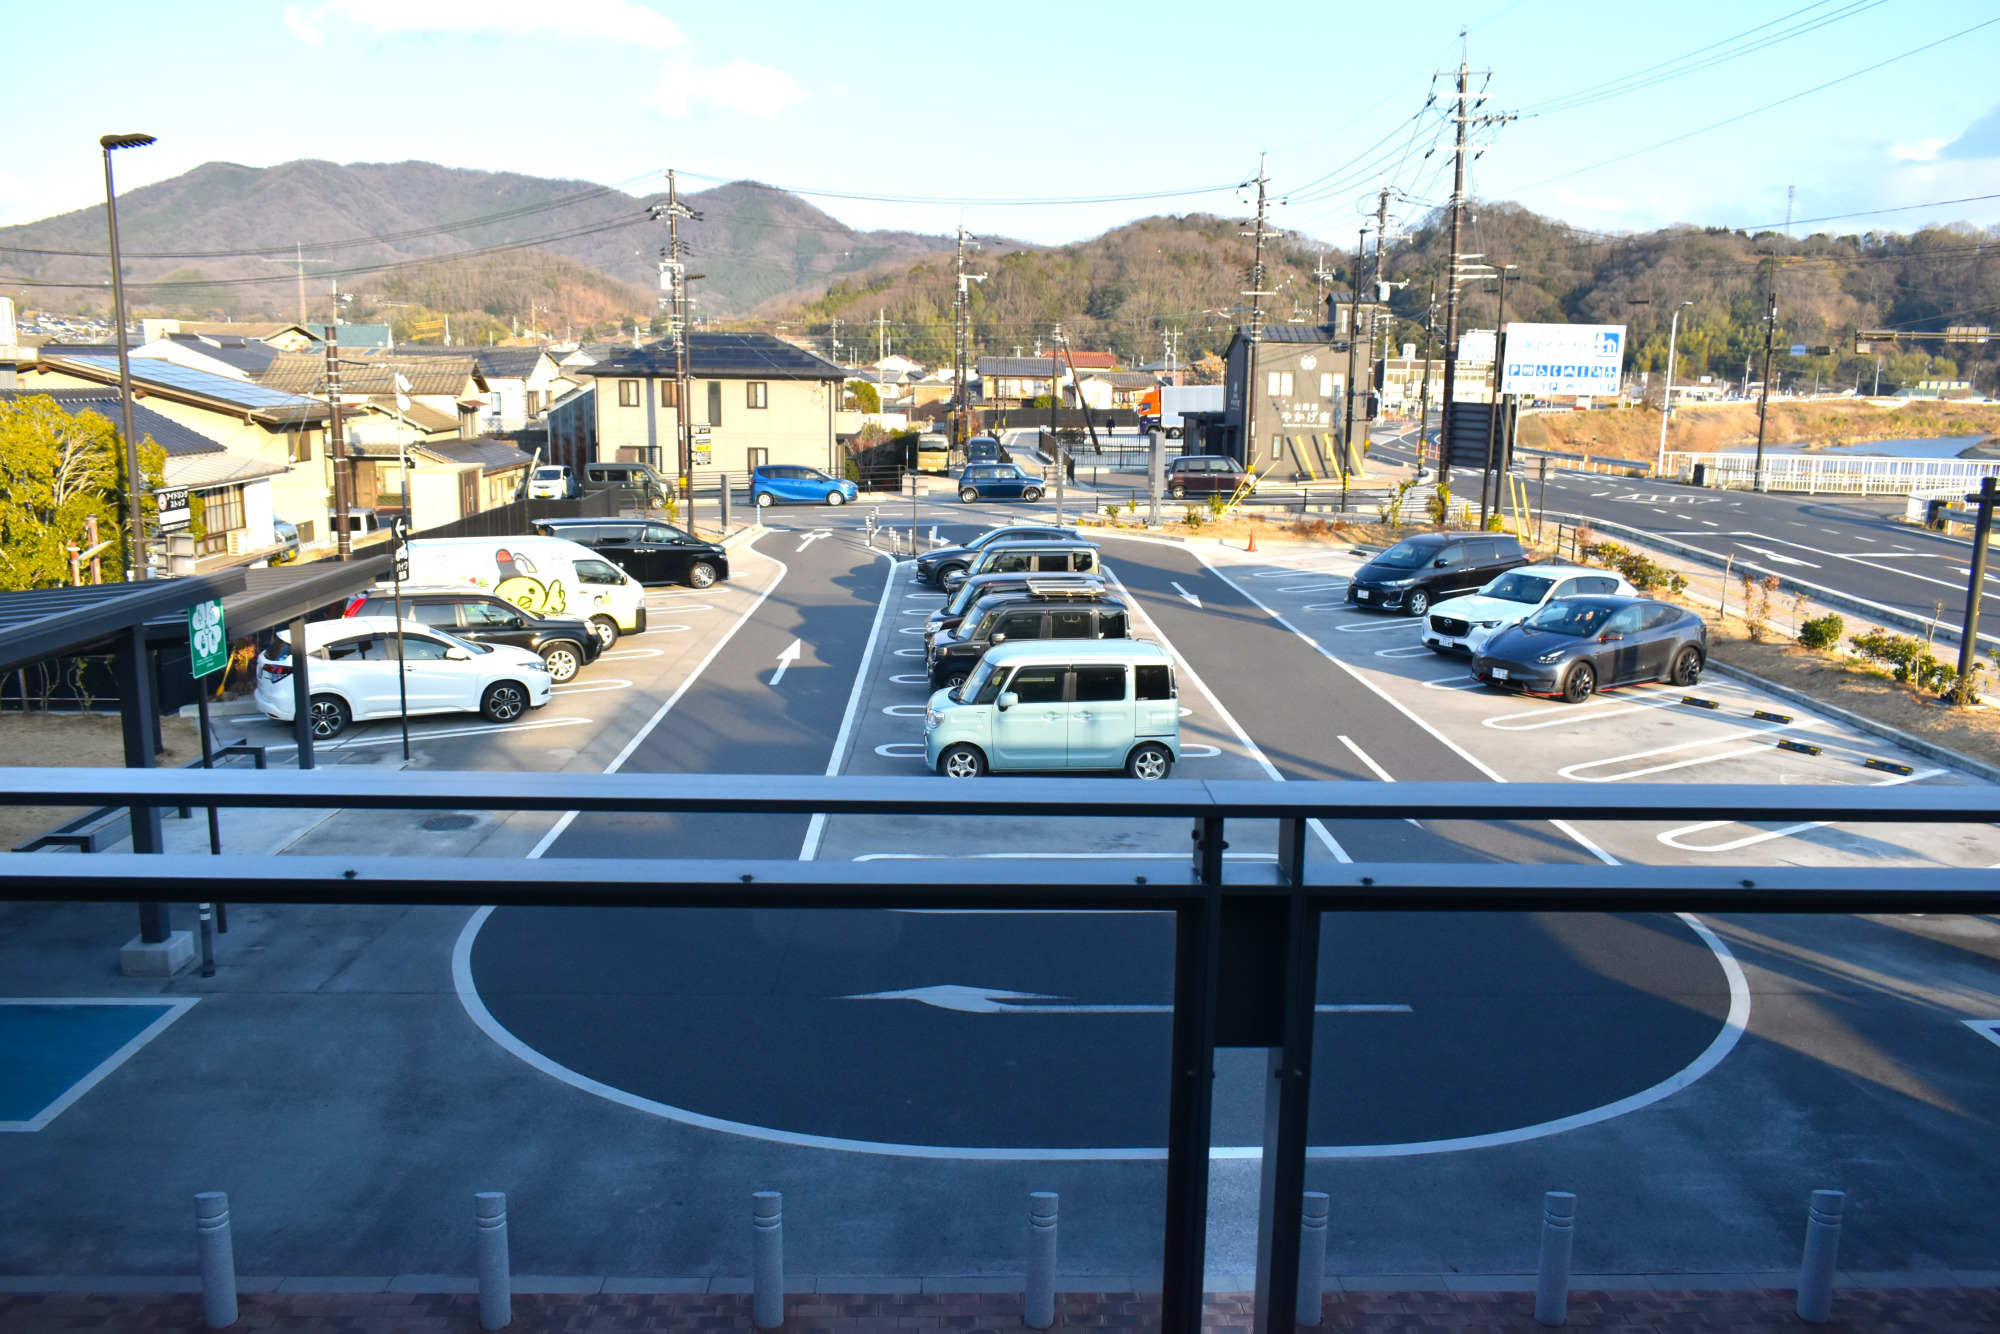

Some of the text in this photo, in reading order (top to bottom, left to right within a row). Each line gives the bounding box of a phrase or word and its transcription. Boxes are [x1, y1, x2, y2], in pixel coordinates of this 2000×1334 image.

[1281, 411, 1331, 424] やかげ宿
[166, 490, 188, 501] アイドリング
[170, 498, 186, 508] ストップ
[396, 561, 408, 572] バイク
